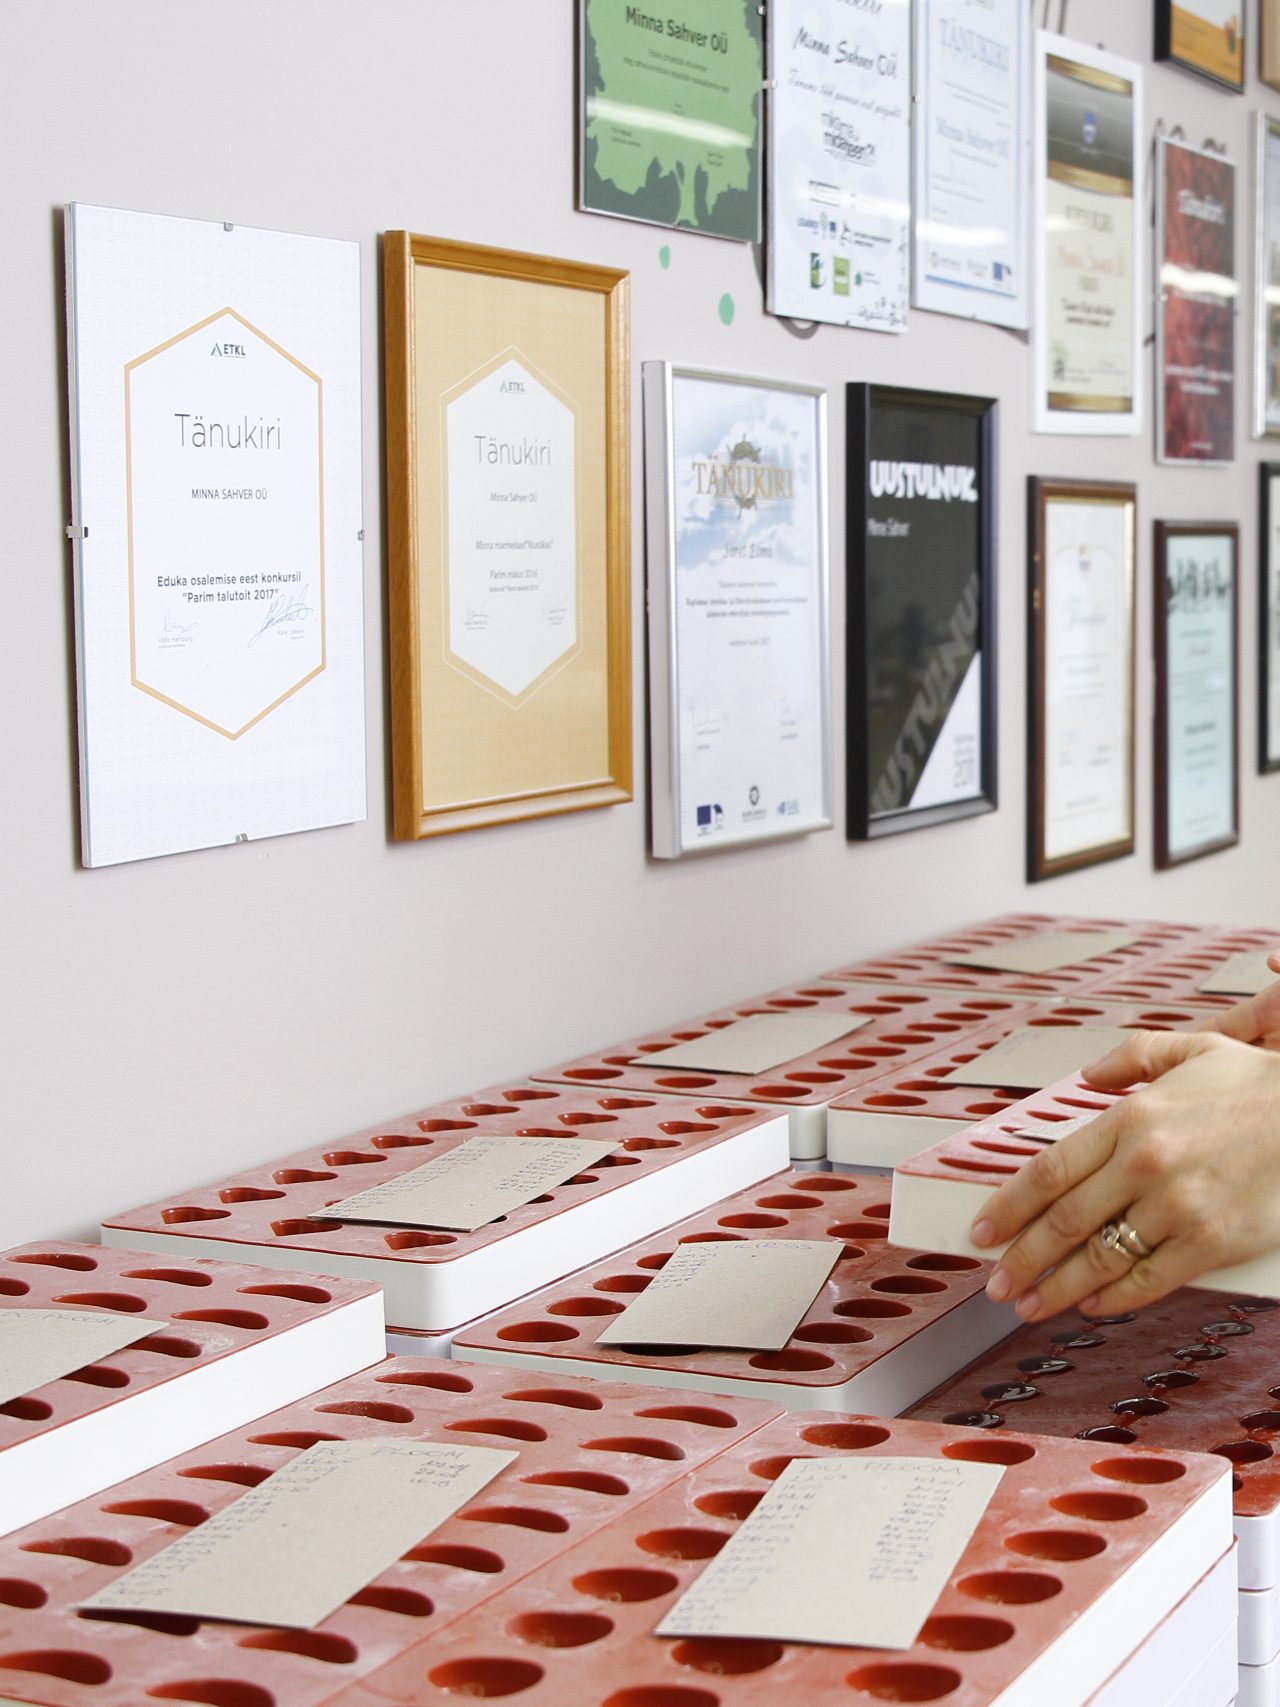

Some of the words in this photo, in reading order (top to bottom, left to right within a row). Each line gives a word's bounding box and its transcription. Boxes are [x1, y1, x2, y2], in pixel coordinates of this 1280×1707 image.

[626, 5, 663, 33] Minna
[667, 19, 708, 48] Sahver
[711, 31, 728, 54] OÜ
[224, 344, 246, 356] ETKL
[508, 381, 526, 393] ETKL
[174, 413, 281, 450] Tänukiri
[474, 435, 552, 466] Tänukiri
[692, 453, 795, 500] TÄNUKIRI
[191, 488, 220, 500] MINNA
[222, 488, 253, 501] SAHVER
[255, 487, 268, 500] OÜ
[157, 575, 188, 587] Eduka
[190, 574, 237, 586] osalemise
[239, 573, 259, 585] eest
[261, 571, 301, 583] konkursil
[183, 592, 214, 603] "Parim
[217, 589, 251, 602] talutoit
[254, 588, 279, 600] 2017"
